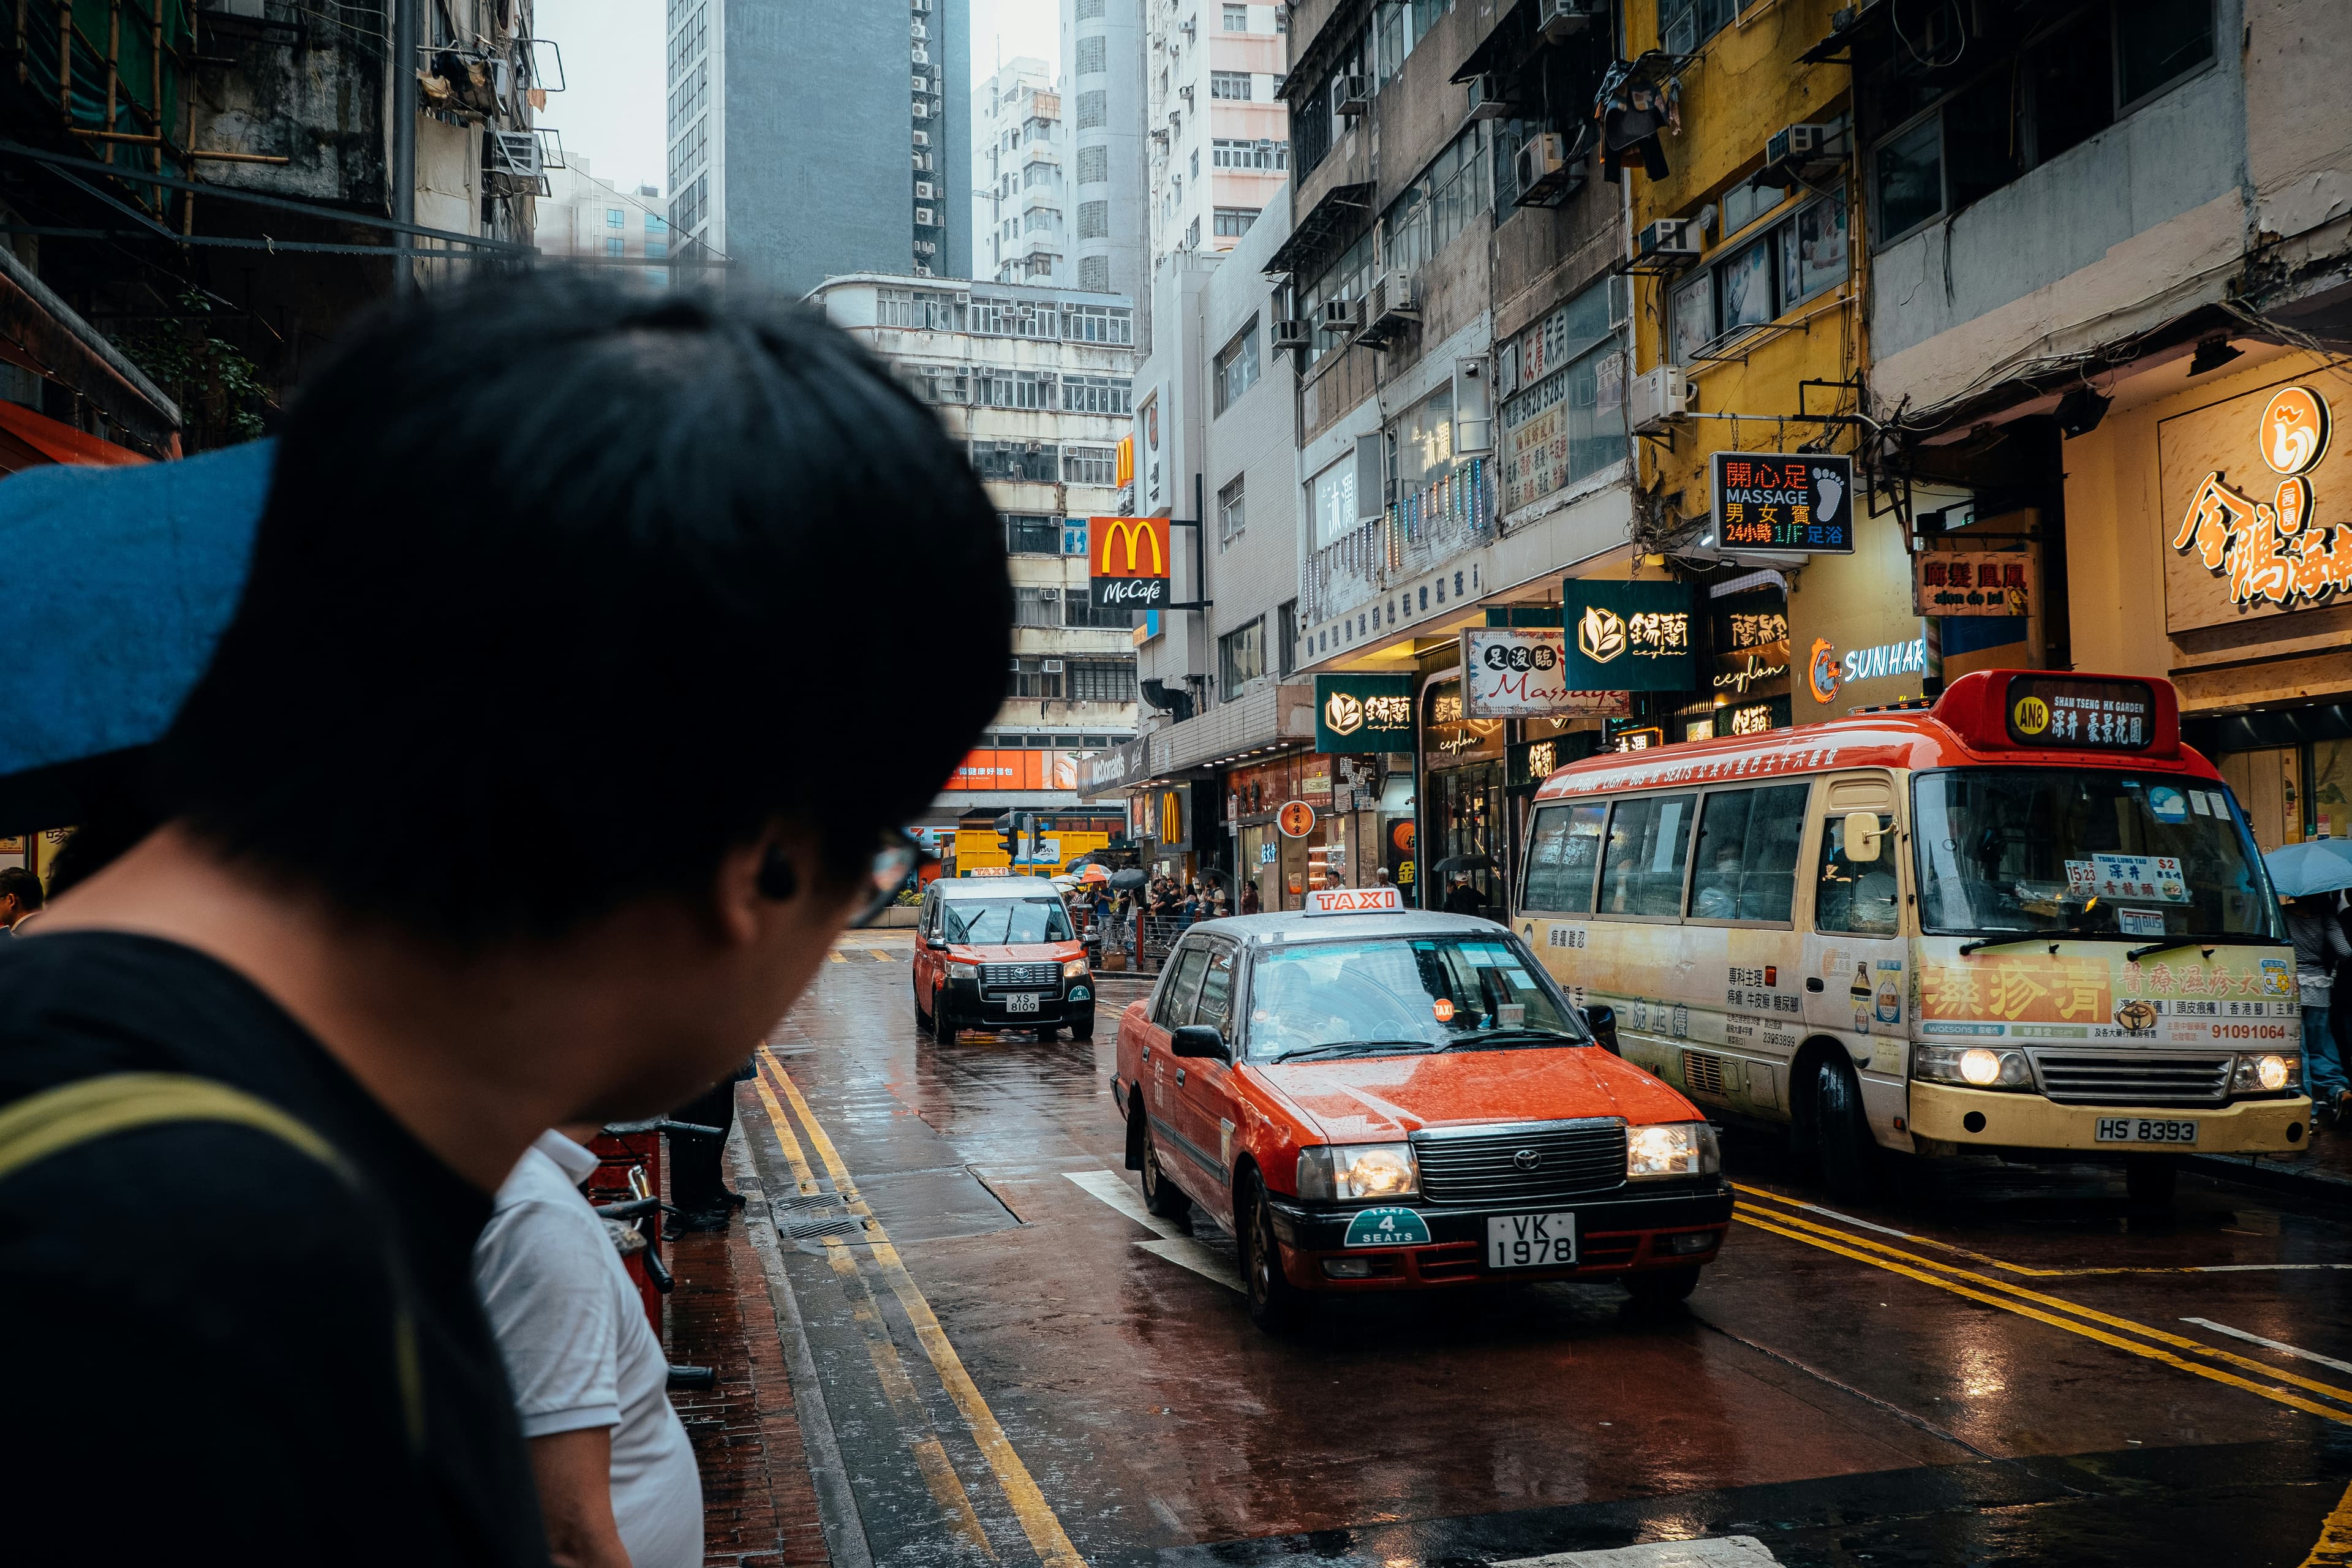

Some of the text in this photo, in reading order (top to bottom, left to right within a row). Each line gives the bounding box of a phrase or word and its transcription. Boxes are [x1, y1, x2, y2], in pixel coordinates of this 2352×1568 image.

[1525, 311, 1564, 382] 皮膚尿病
[1544, 372, 1564, 408] 5283
[1727, 462, 1809, 489] 開心足
[1727, 489, 1808, 505] MASSAGE
[1808, 526, 1843, 545] 足浴
[1104, 579, 1161, 604] McCafé
[1629, 612, 1689, 647] 錫蘭
[1632, 646, 1688, 659] ceylon
[1713, 655, 1785, 693] ceylon
[2054, 696, 2144, 714] SHAM TSENG HK GARDEN
[2020, 703, 2043, 728] AN8
[1366, 722, 1411, 732] ceylon
[2052, 710, 2142, 745] 深井 豪景花園
[1440, 729, 1477, 755] ceylon
[1697, 747, 1839, 779] 公共小型巴士十六座位
[1574, 766, 1694, 792] PUBLIC LIGHT BUS 16 SEATS
[2109, 864, 2140, 880] 深井
[2158, 859, 2174, 870] $2
[2068, 867, 2082, 881] 15
[2084, 869, 2096, 881] 23
[2103, 880, 2155, 897] 青龍頭
[1317, 891, 1395, 910] TAXI
[1728, 967, 1762, 987] 專科主理
[1011, 1003, 1036, 1011] 8109
[1017, 994, 1030, 1003] XS
[1747, 992, 1770, 1009] 牛皮癬
[1774, 995, 1798, 1013] 糖尿腳
[1434, 1005, 1452, 1016] TAXI
[2176, 1001, 2215, 1016] 頭皮痕癢
[2230, 1003, 2263, 1016] 香港腳
[1929, 1025, 1973, 1033] watsons
[2212, 1025, 2285, 1039] 91091064
[1763, 1032, 1795, 1047] 23953899
[2100, 1120, 2194, 1140] HS 8393
[1379, 1215, 1395, 1232] 4
[1513, 1215, 1549, 1240] VK
[1363, 1232, 1413, 1242] SEATS
[1498, 1237, 1572, 1266] 1978
